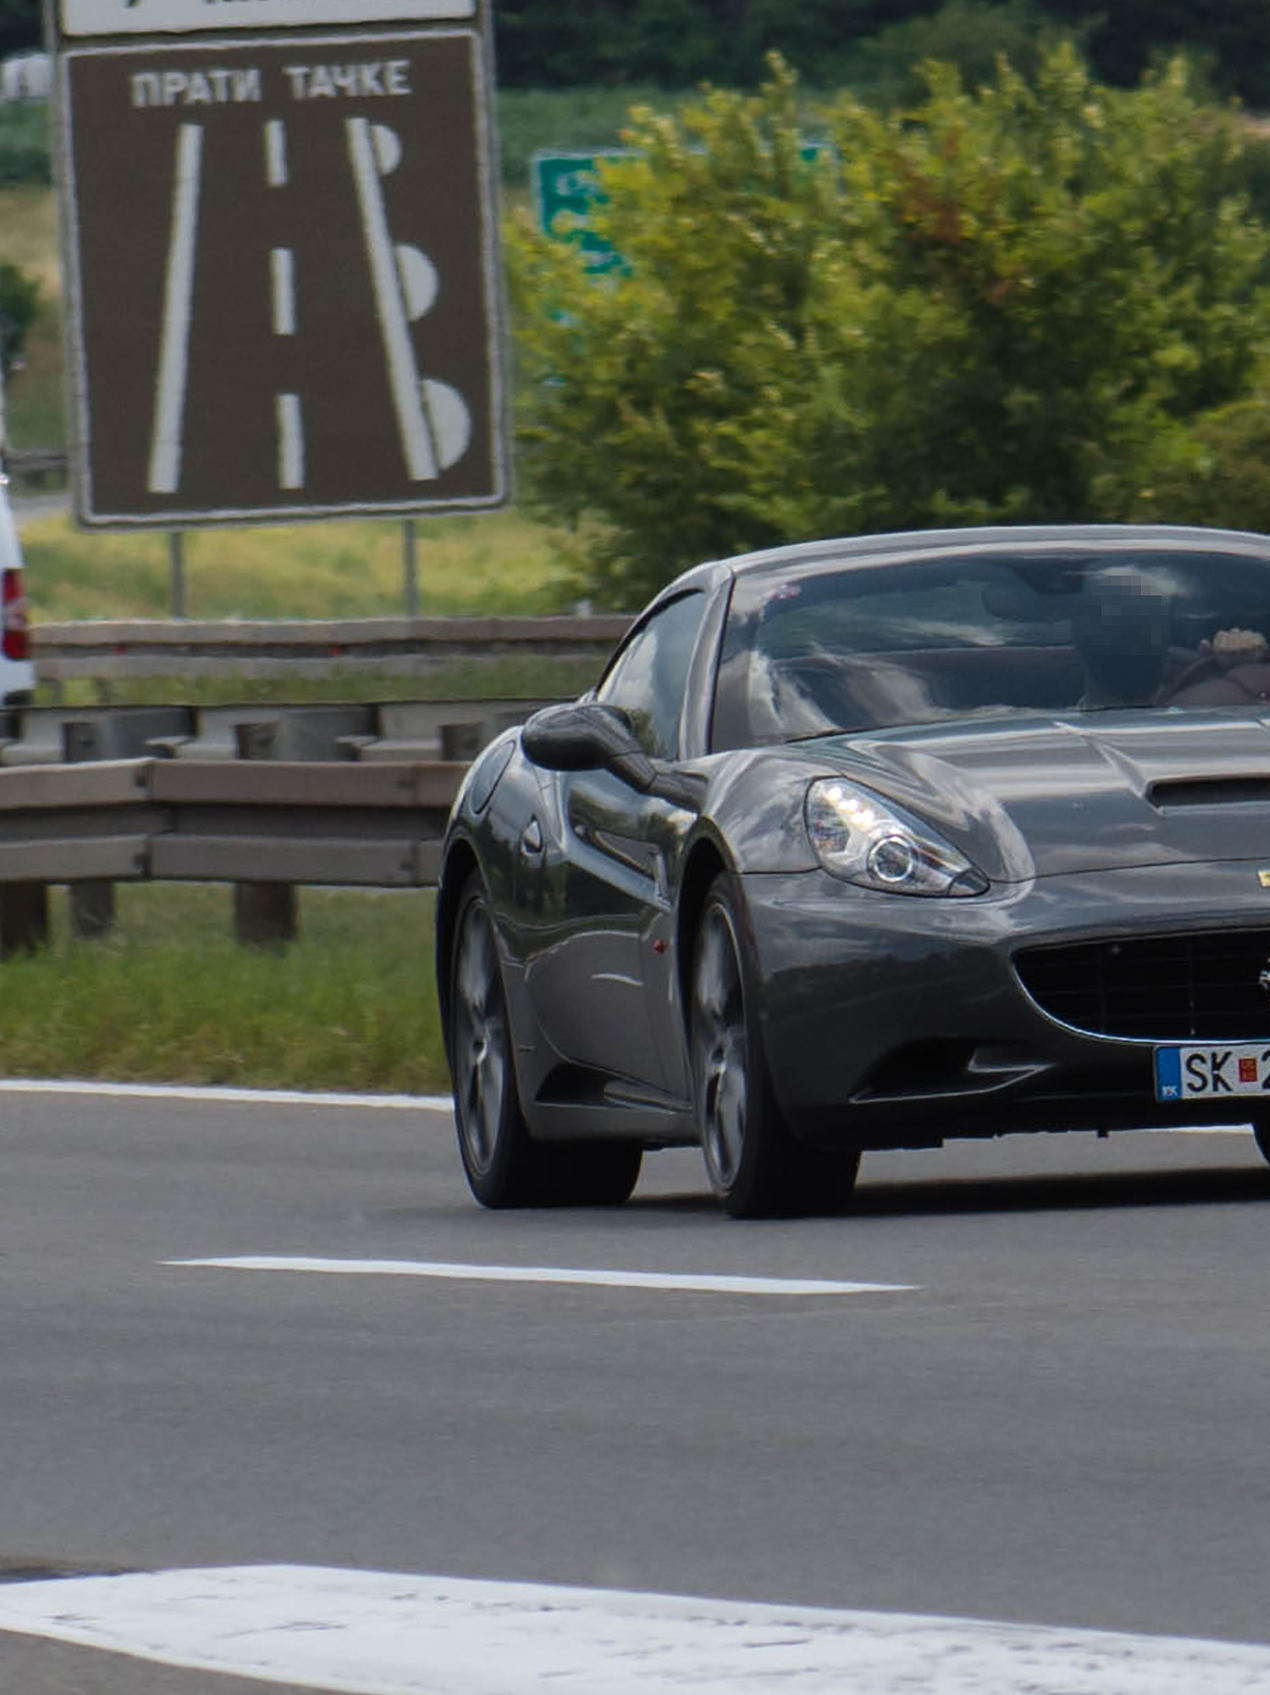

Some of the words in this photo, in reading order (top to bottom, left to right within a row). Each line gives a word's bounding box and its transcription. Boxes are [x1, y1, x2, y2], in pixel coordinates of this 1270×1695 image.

[131, 69, 262, 108] ПРАТИ
[283, 59, 412, 98] ТАЧКЕ
[1186, 1052, 1232, 1093] SK
